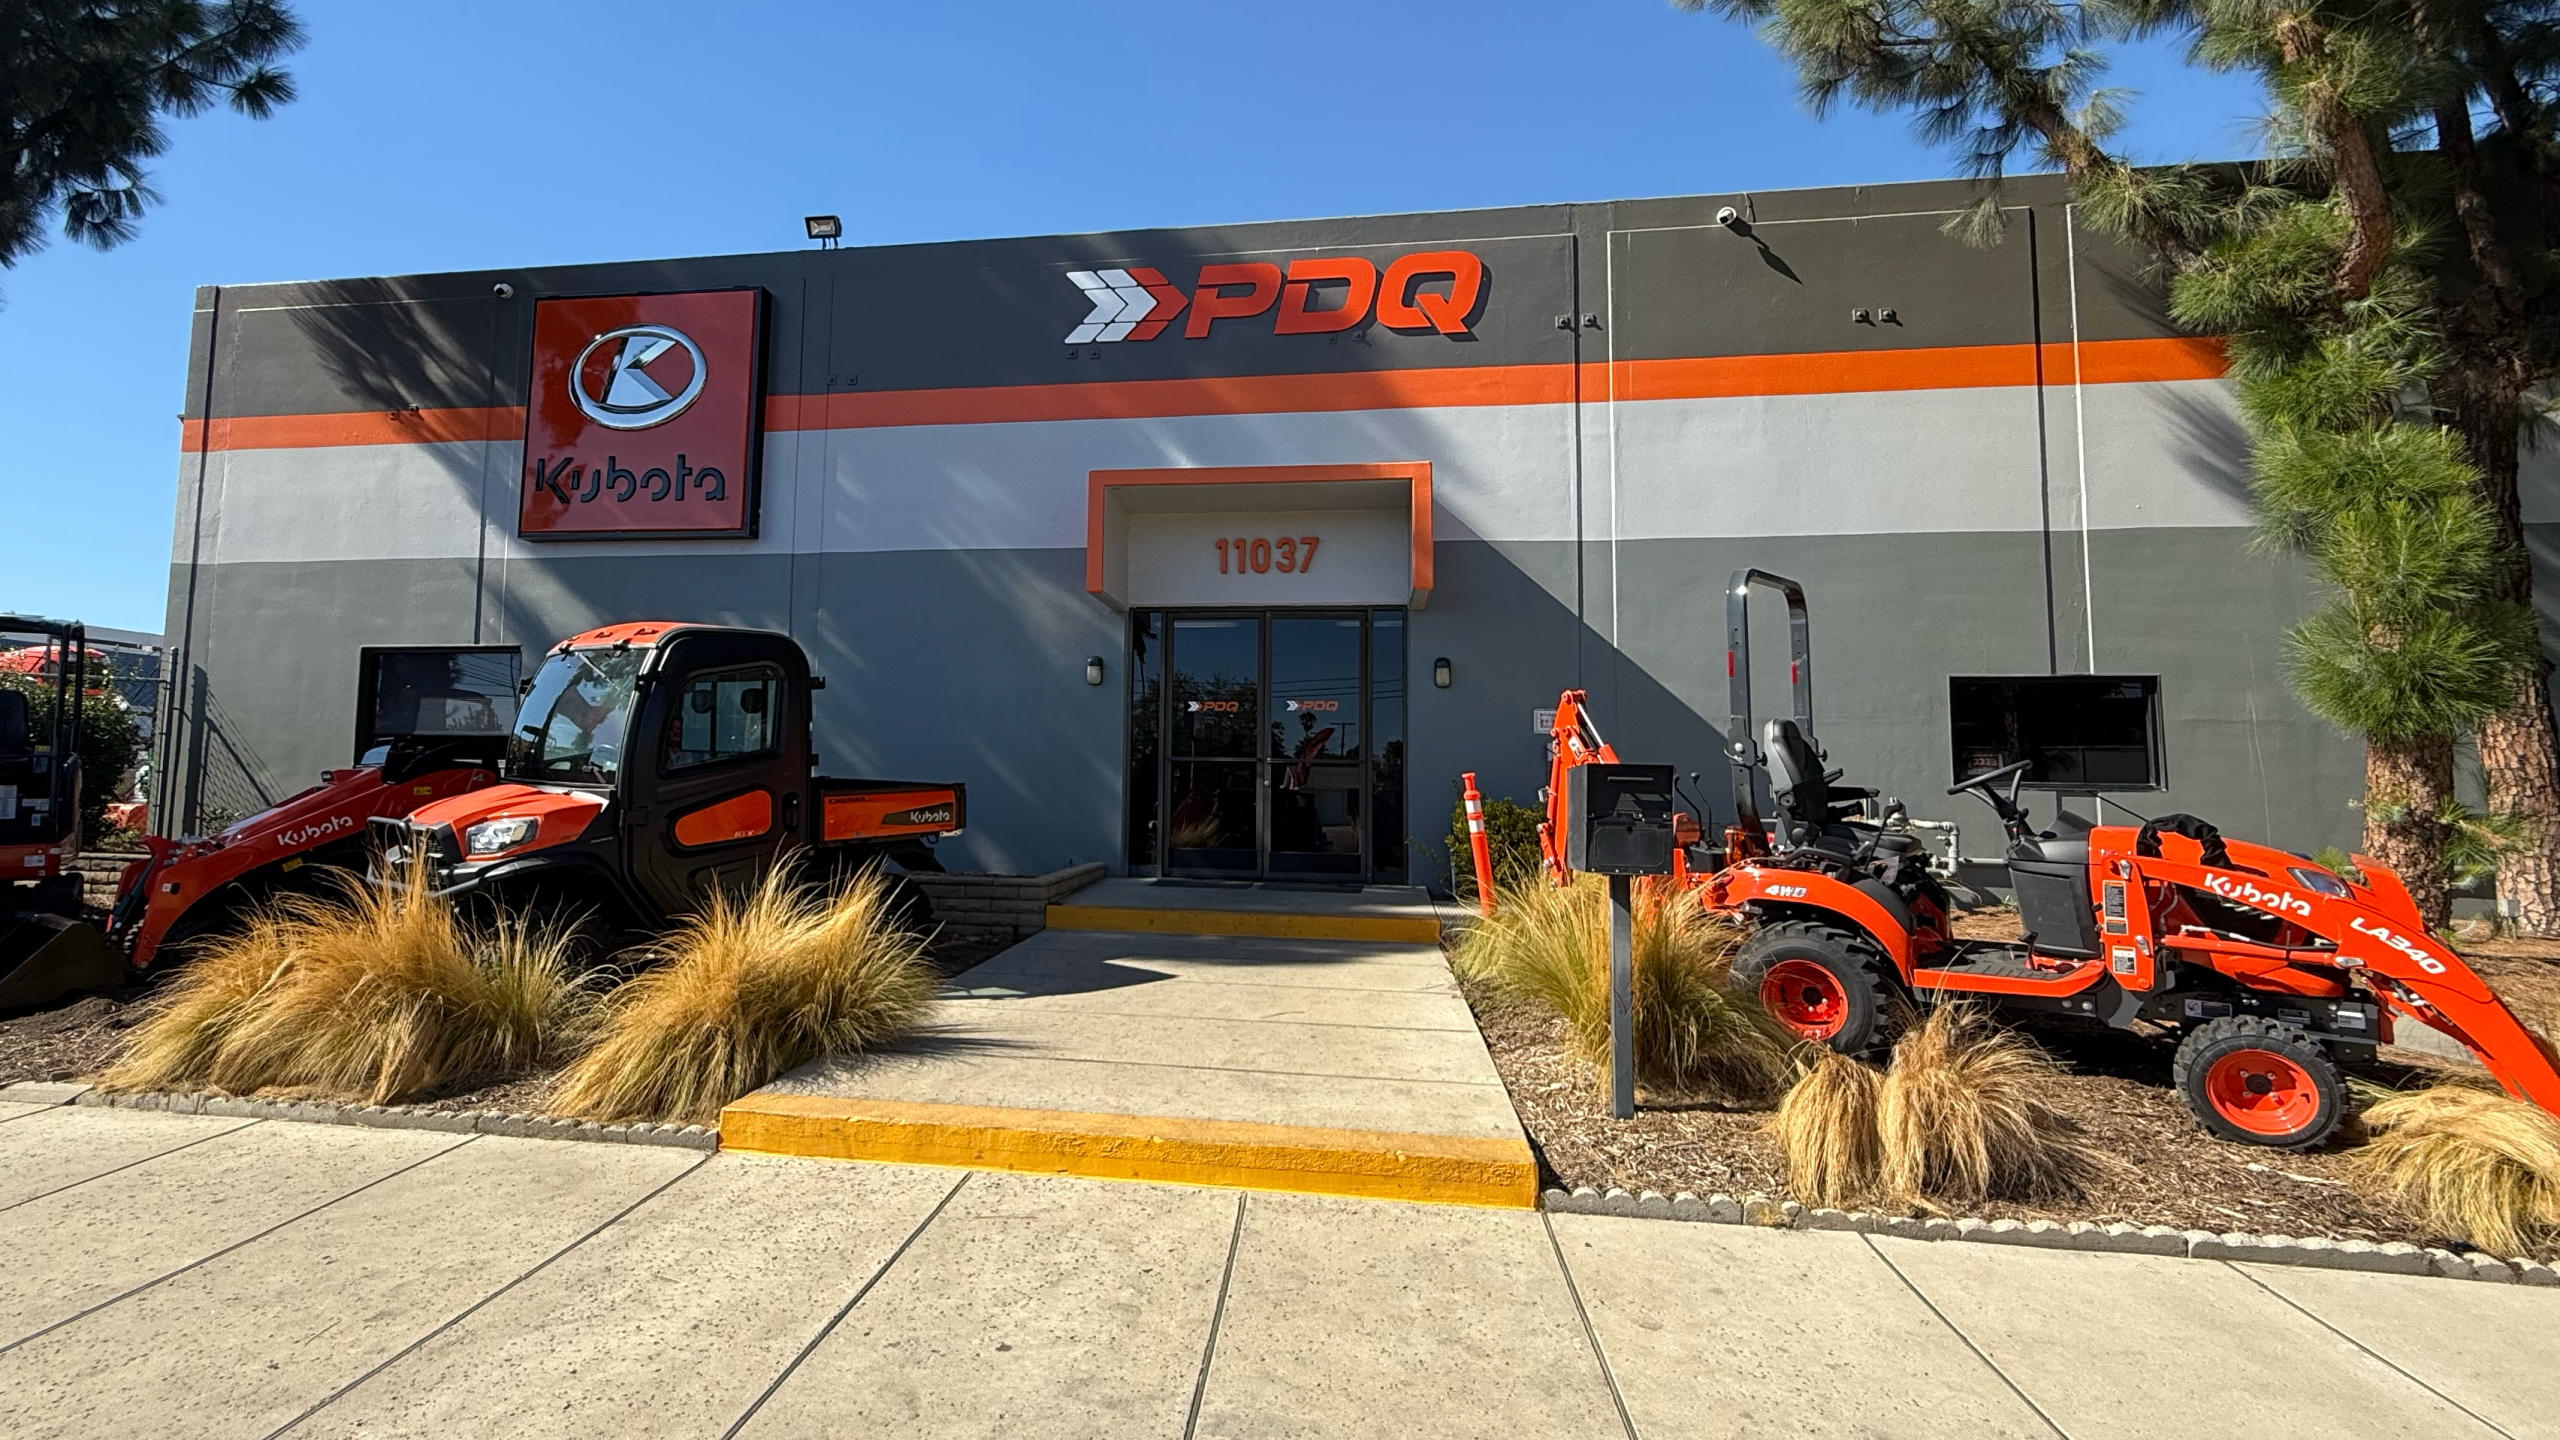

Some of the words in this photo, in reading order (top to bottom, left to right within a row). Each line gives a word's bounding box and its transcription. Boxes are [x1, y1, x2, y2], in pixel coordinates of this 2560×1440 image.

[1185, 250, 1483, 339] PDQ
[534, 453, 727, 504] Kubota
[1214, 536, 1321, 574] 11037
[1202, 701, 1239, 713] PDQ
[1301, 700, 1339, 712] PDQ
[276, 815, 354, 846] Kubota
[910, 809, 950, 823] Kubota
[1764, 884, 1808, 899] 4WD
[2203, 872, 2313, 917] Kubota
[2349, 916, 2447, 975] LA340
